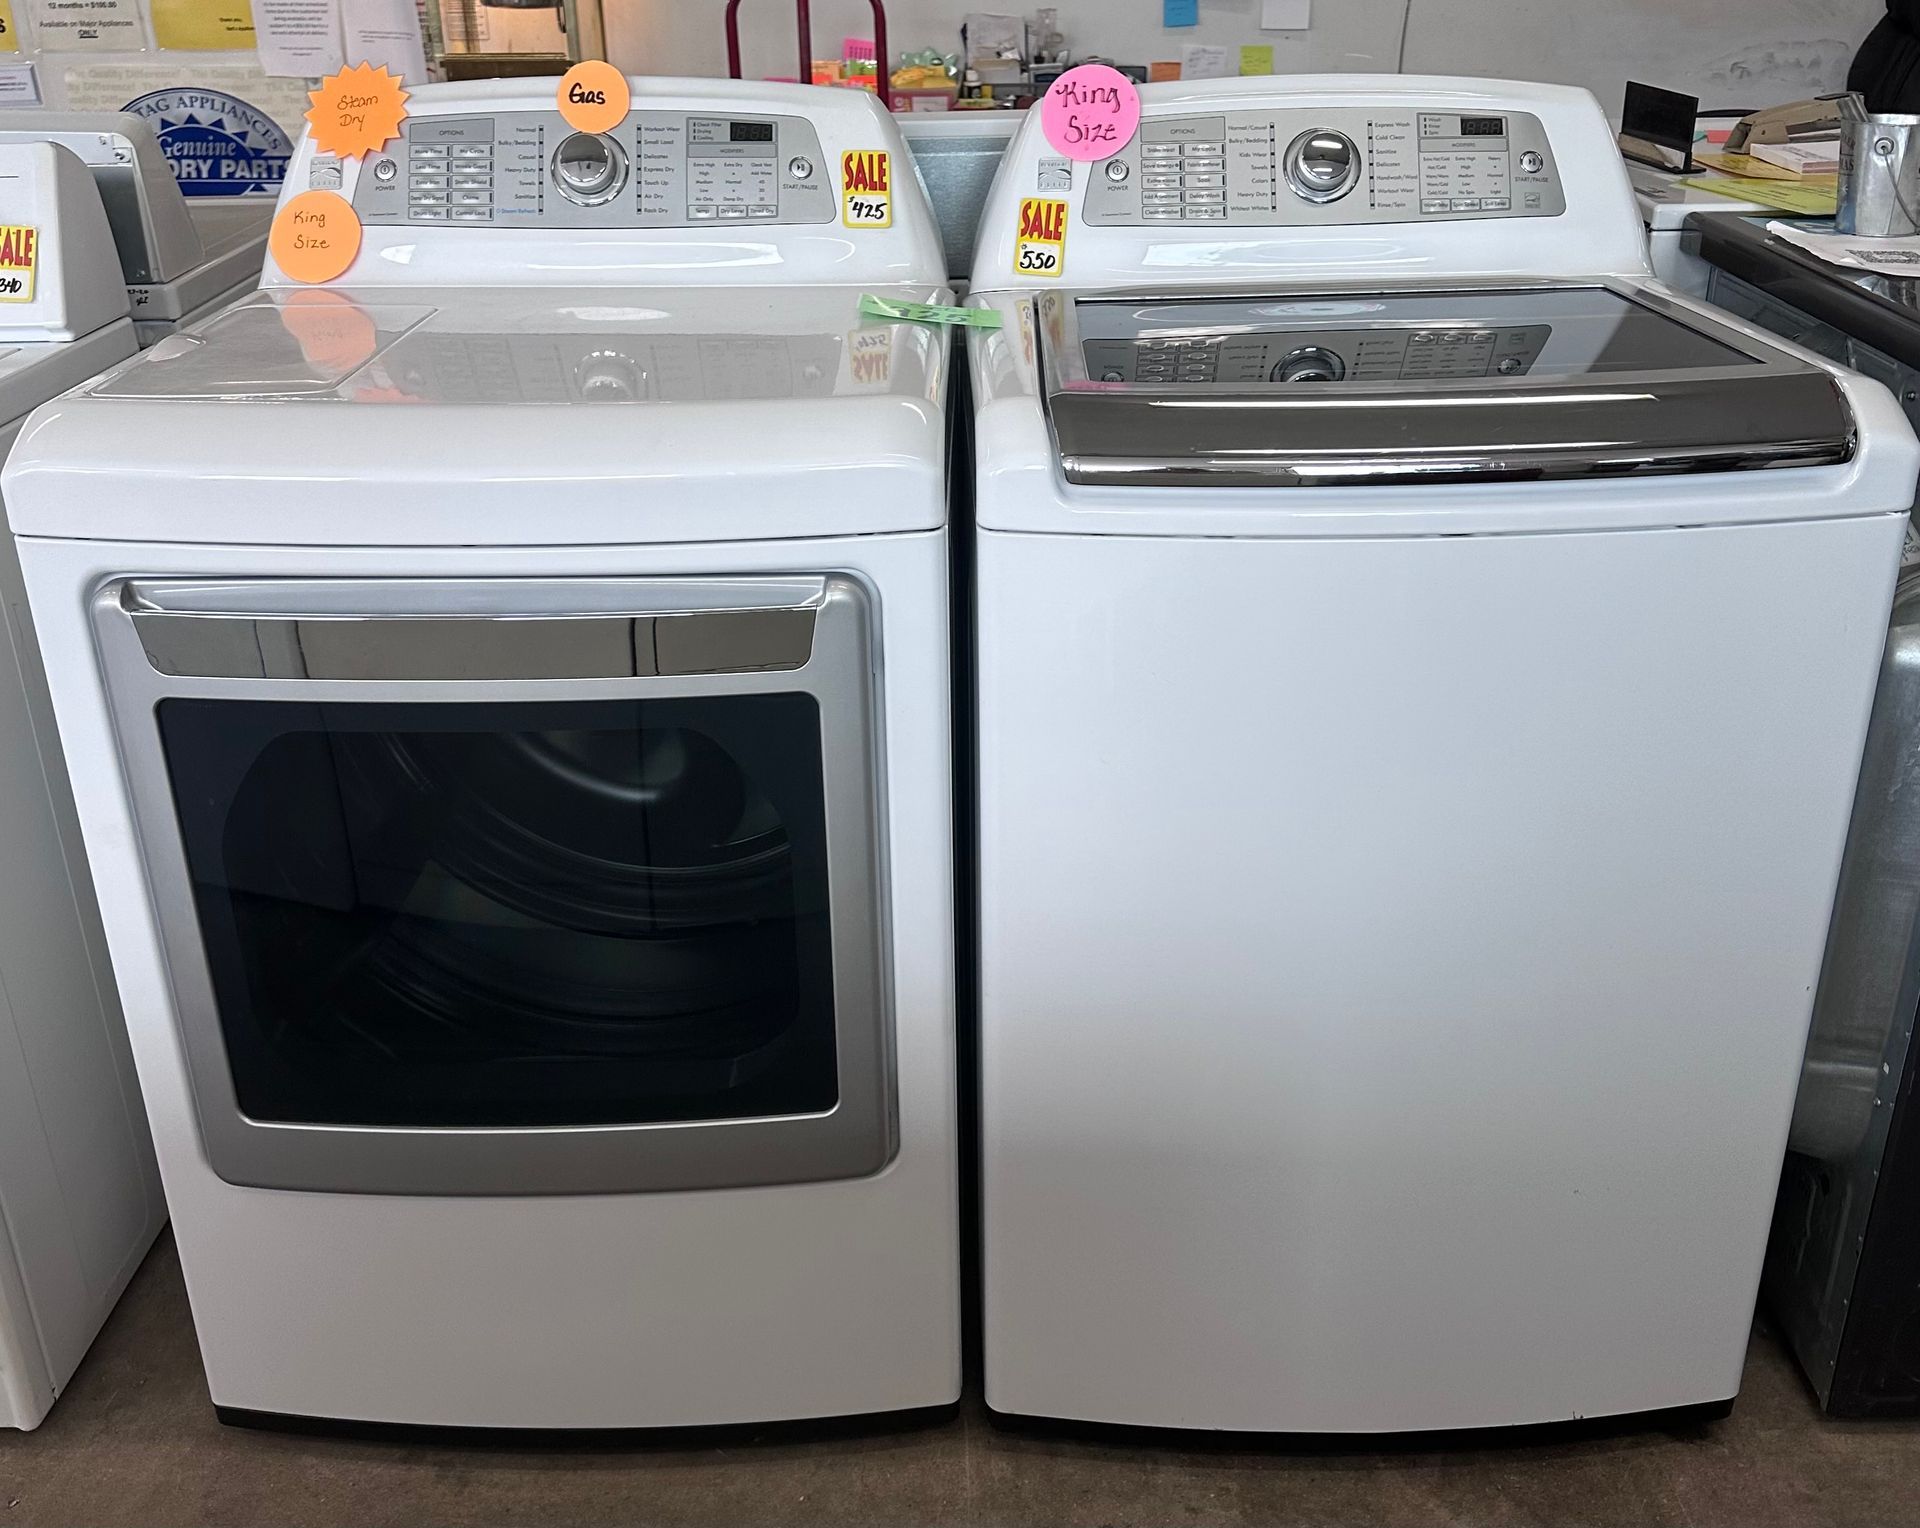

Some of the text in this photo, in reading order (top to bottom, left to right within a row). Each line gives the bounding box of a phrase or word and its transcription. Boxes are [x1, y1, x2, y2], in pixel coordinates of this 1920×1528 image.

[337, 94, 379, 111] Steam
[568, 82, 606, 104] Gas
[1055, 81, 1121, 114] King
[134, 95, 282, 150] TAG APPLIANCES
[339, 114, 366, 132] Dry
[1064, 115, 1118, 143] Size
[158, 135, 237, 157] Genuine
[170, 158, 213, 179] DRY
[844, 152, 887, 192] SALE
[293, 210, 326, 228] King
[1020, 201, 1065, 241] SALE
[0, 228, 34, 267] ALE
[293, 234, 330, 249] Size
